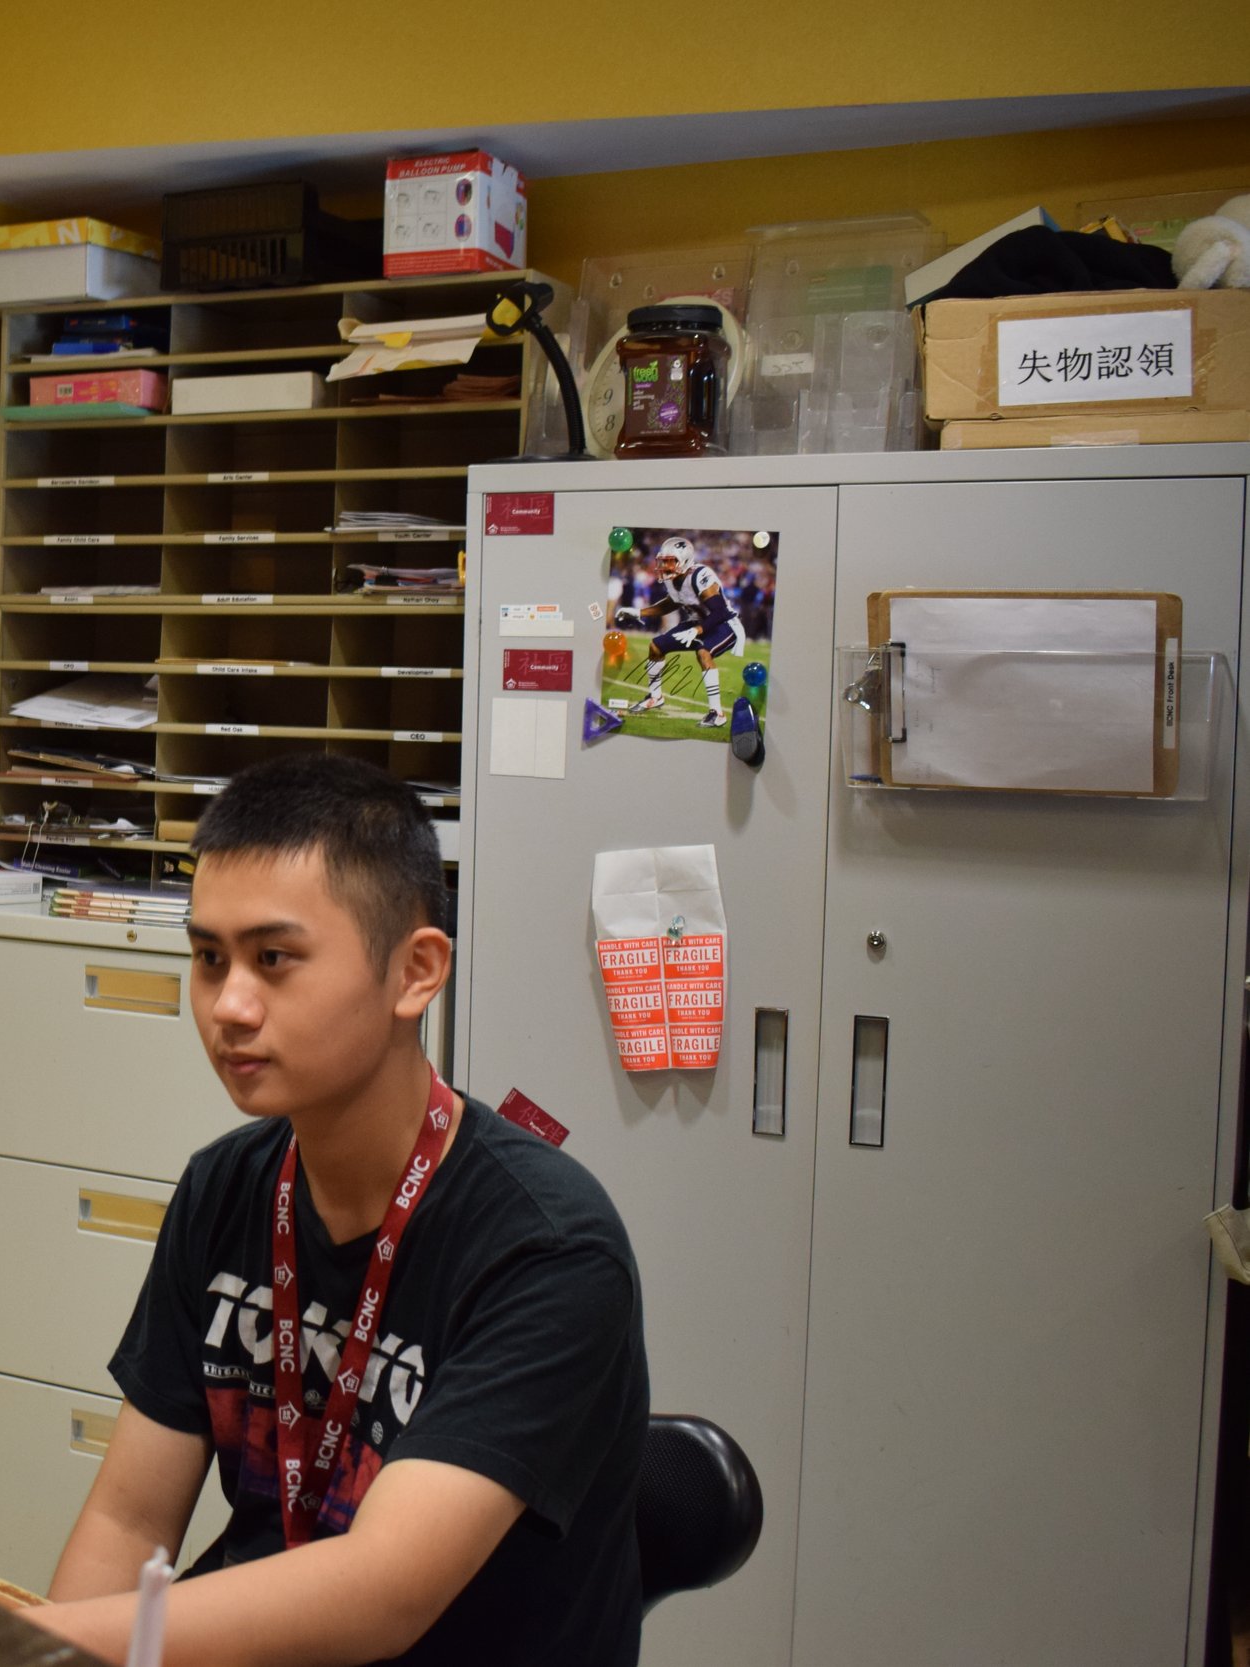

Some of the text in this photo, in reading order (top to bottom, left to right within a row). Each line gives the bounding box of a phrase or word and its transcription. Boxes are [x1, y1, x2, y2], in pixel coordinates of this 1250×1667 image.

[399, 164, 467, 178] BALLOON PUMP
[1017, 342, 1174, 386] 失物認領
[530, 664, 559, 672] Community
[600, 940, 657, 950] HANDLE WITH CARE
[688, 937, 704, 945] WITH
[602, 951, 657, 967] FRAGILE
[665, 948, 719, 963] FRAGILE
[627, 985, 643, 993] WITH
[649, 1028, 664, 1036] CARE
[395, 1155, 431, 1209] BCNC
[277, 1181, 291, 1235] BCNC
[354, 1287, 380, 1342] BCNC
[279, 1319, 295, 1373] BCNC
[314, 1419, 343, 1470] BCNC
